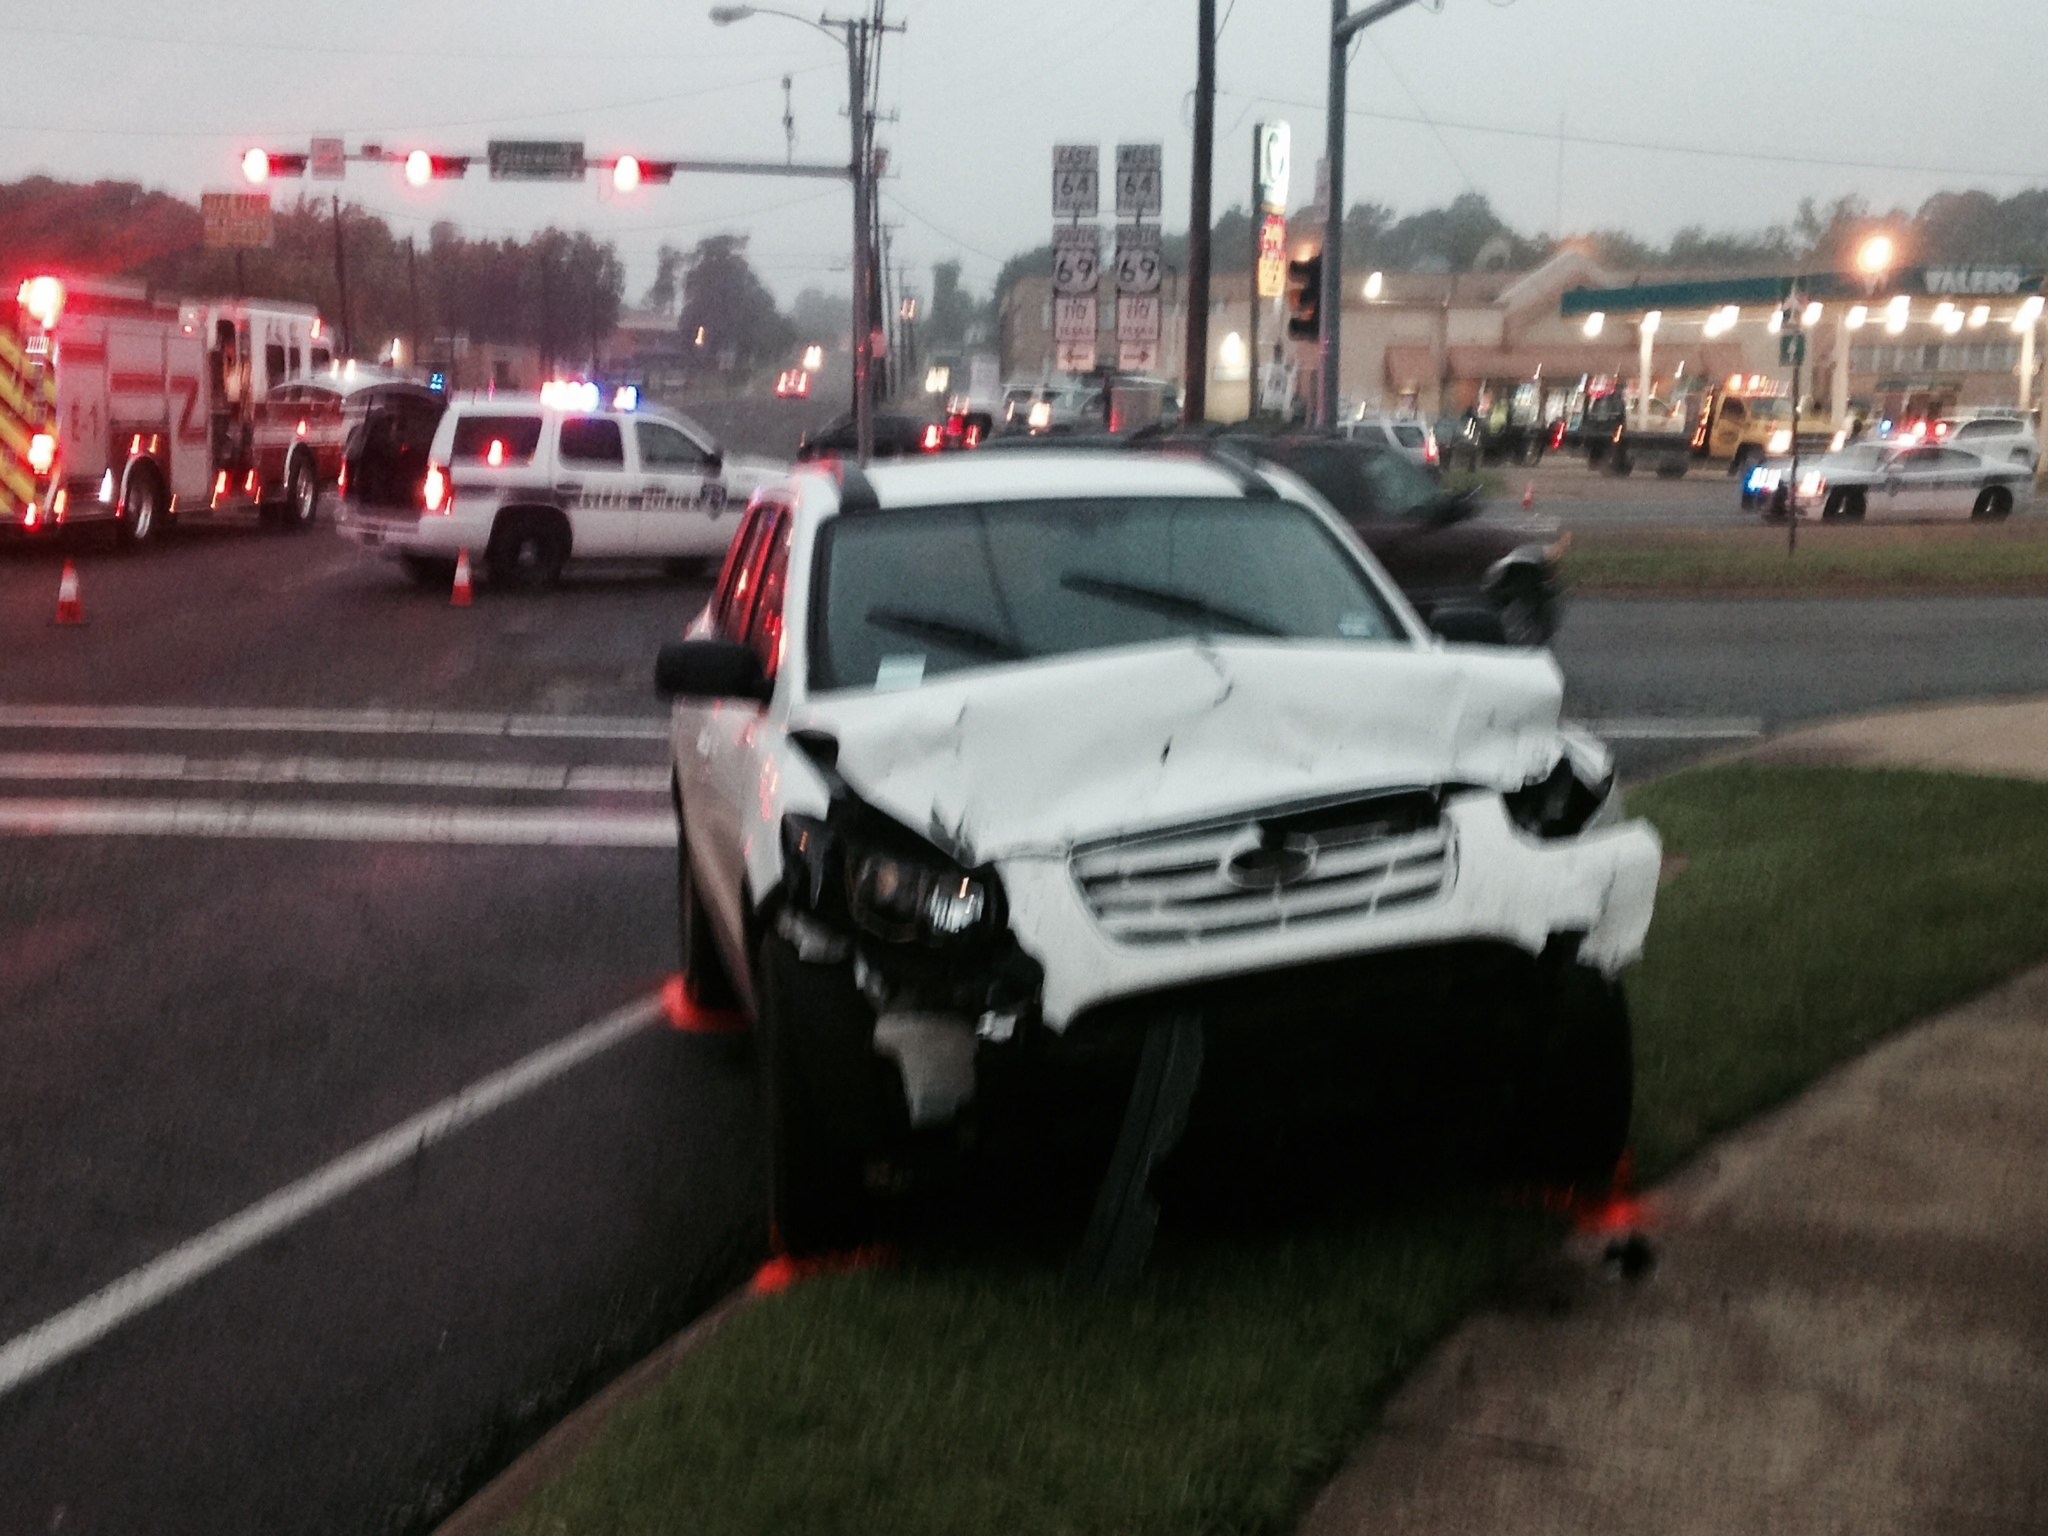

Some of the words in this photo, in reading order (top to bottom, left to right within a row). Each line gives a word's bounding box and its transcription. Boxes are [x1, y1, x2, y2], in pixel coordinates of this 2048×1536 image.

[1061, 175, 1089, 196] 64
[1124, 175, 1152, 196] 64
[1057, 258, 1093, 283] 69
[1120, 258, 1155, 282] 69
[1925, 270, 2020, 294] VALERO
[1064, 304, 1086, 320] 110
[1127, 304, 1149, 320] 110
